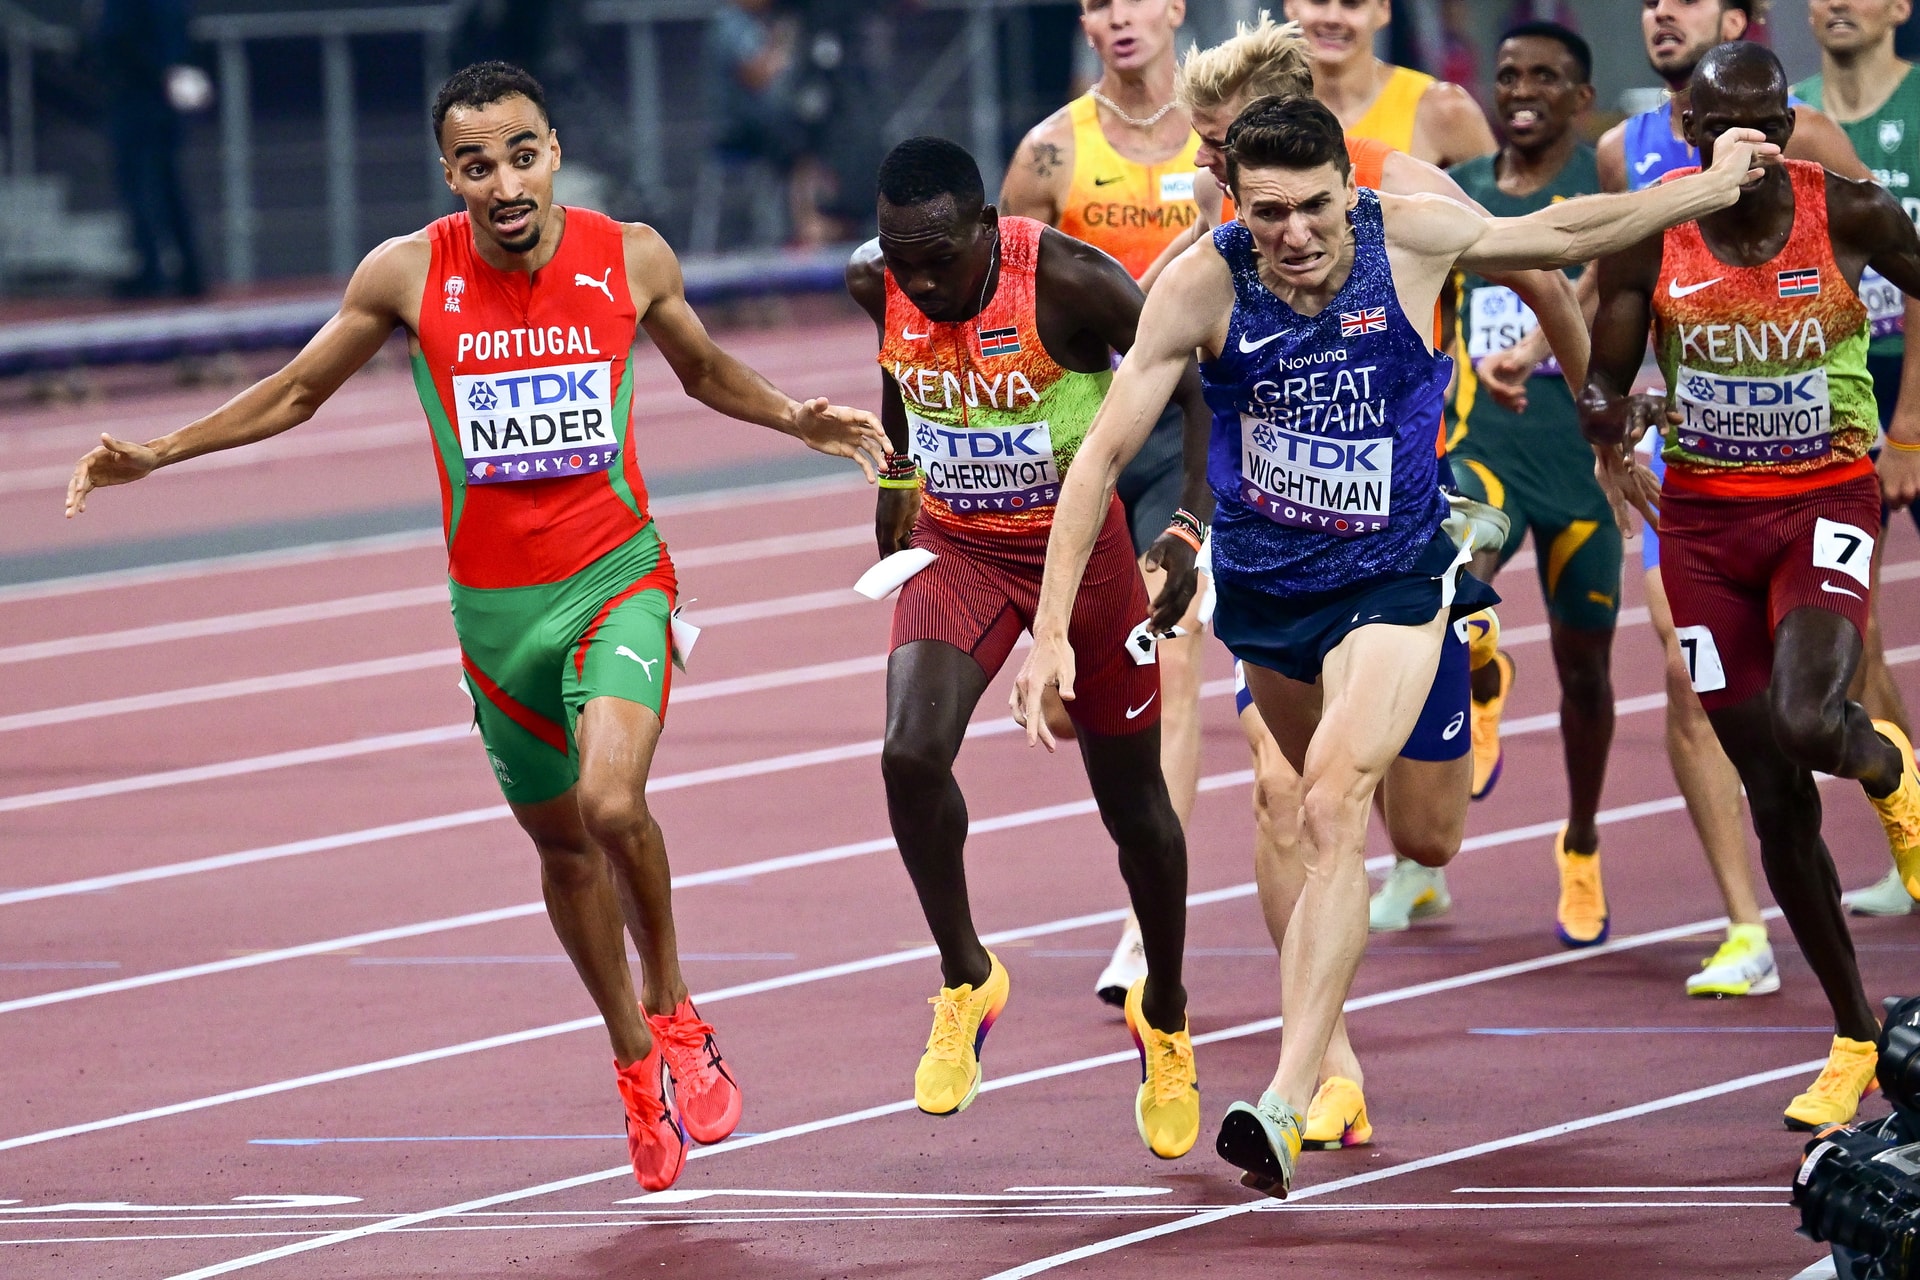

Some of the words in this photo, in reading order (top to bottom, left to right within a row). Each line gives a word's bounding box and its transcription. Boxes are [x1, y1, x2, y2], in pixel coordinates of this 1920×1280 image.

[444, 303, 460, 313] FPA
[457, 326, 600, 362] PORTUGAL
[1678, 317, 1826, 363] KENYA
[1279, 349, 1347, 372] Novuna
[496, 369, 599, 408] TDK
[894, 361, 1040, 409] KENYA
[1253, 366, 1376, 404] GREAT
[1714, 376, 1816, 406] TDK
[470, 408, 605, 451] NADER
[1248, 399, 1385, 432] BRITAIN
[1682, 401, 1697, 427] T.
[1702, 405, 1823, 437] CHERUIYOT
[937, 428, 1040, 458] TDK
[1277, 431, 1380, 472] TDK
[930, 461, 1048, 489] CHERUIYOT
[1248, 451, 1382, 511] WIGHTMAN
[1833, 533, 1862, 565] 7
